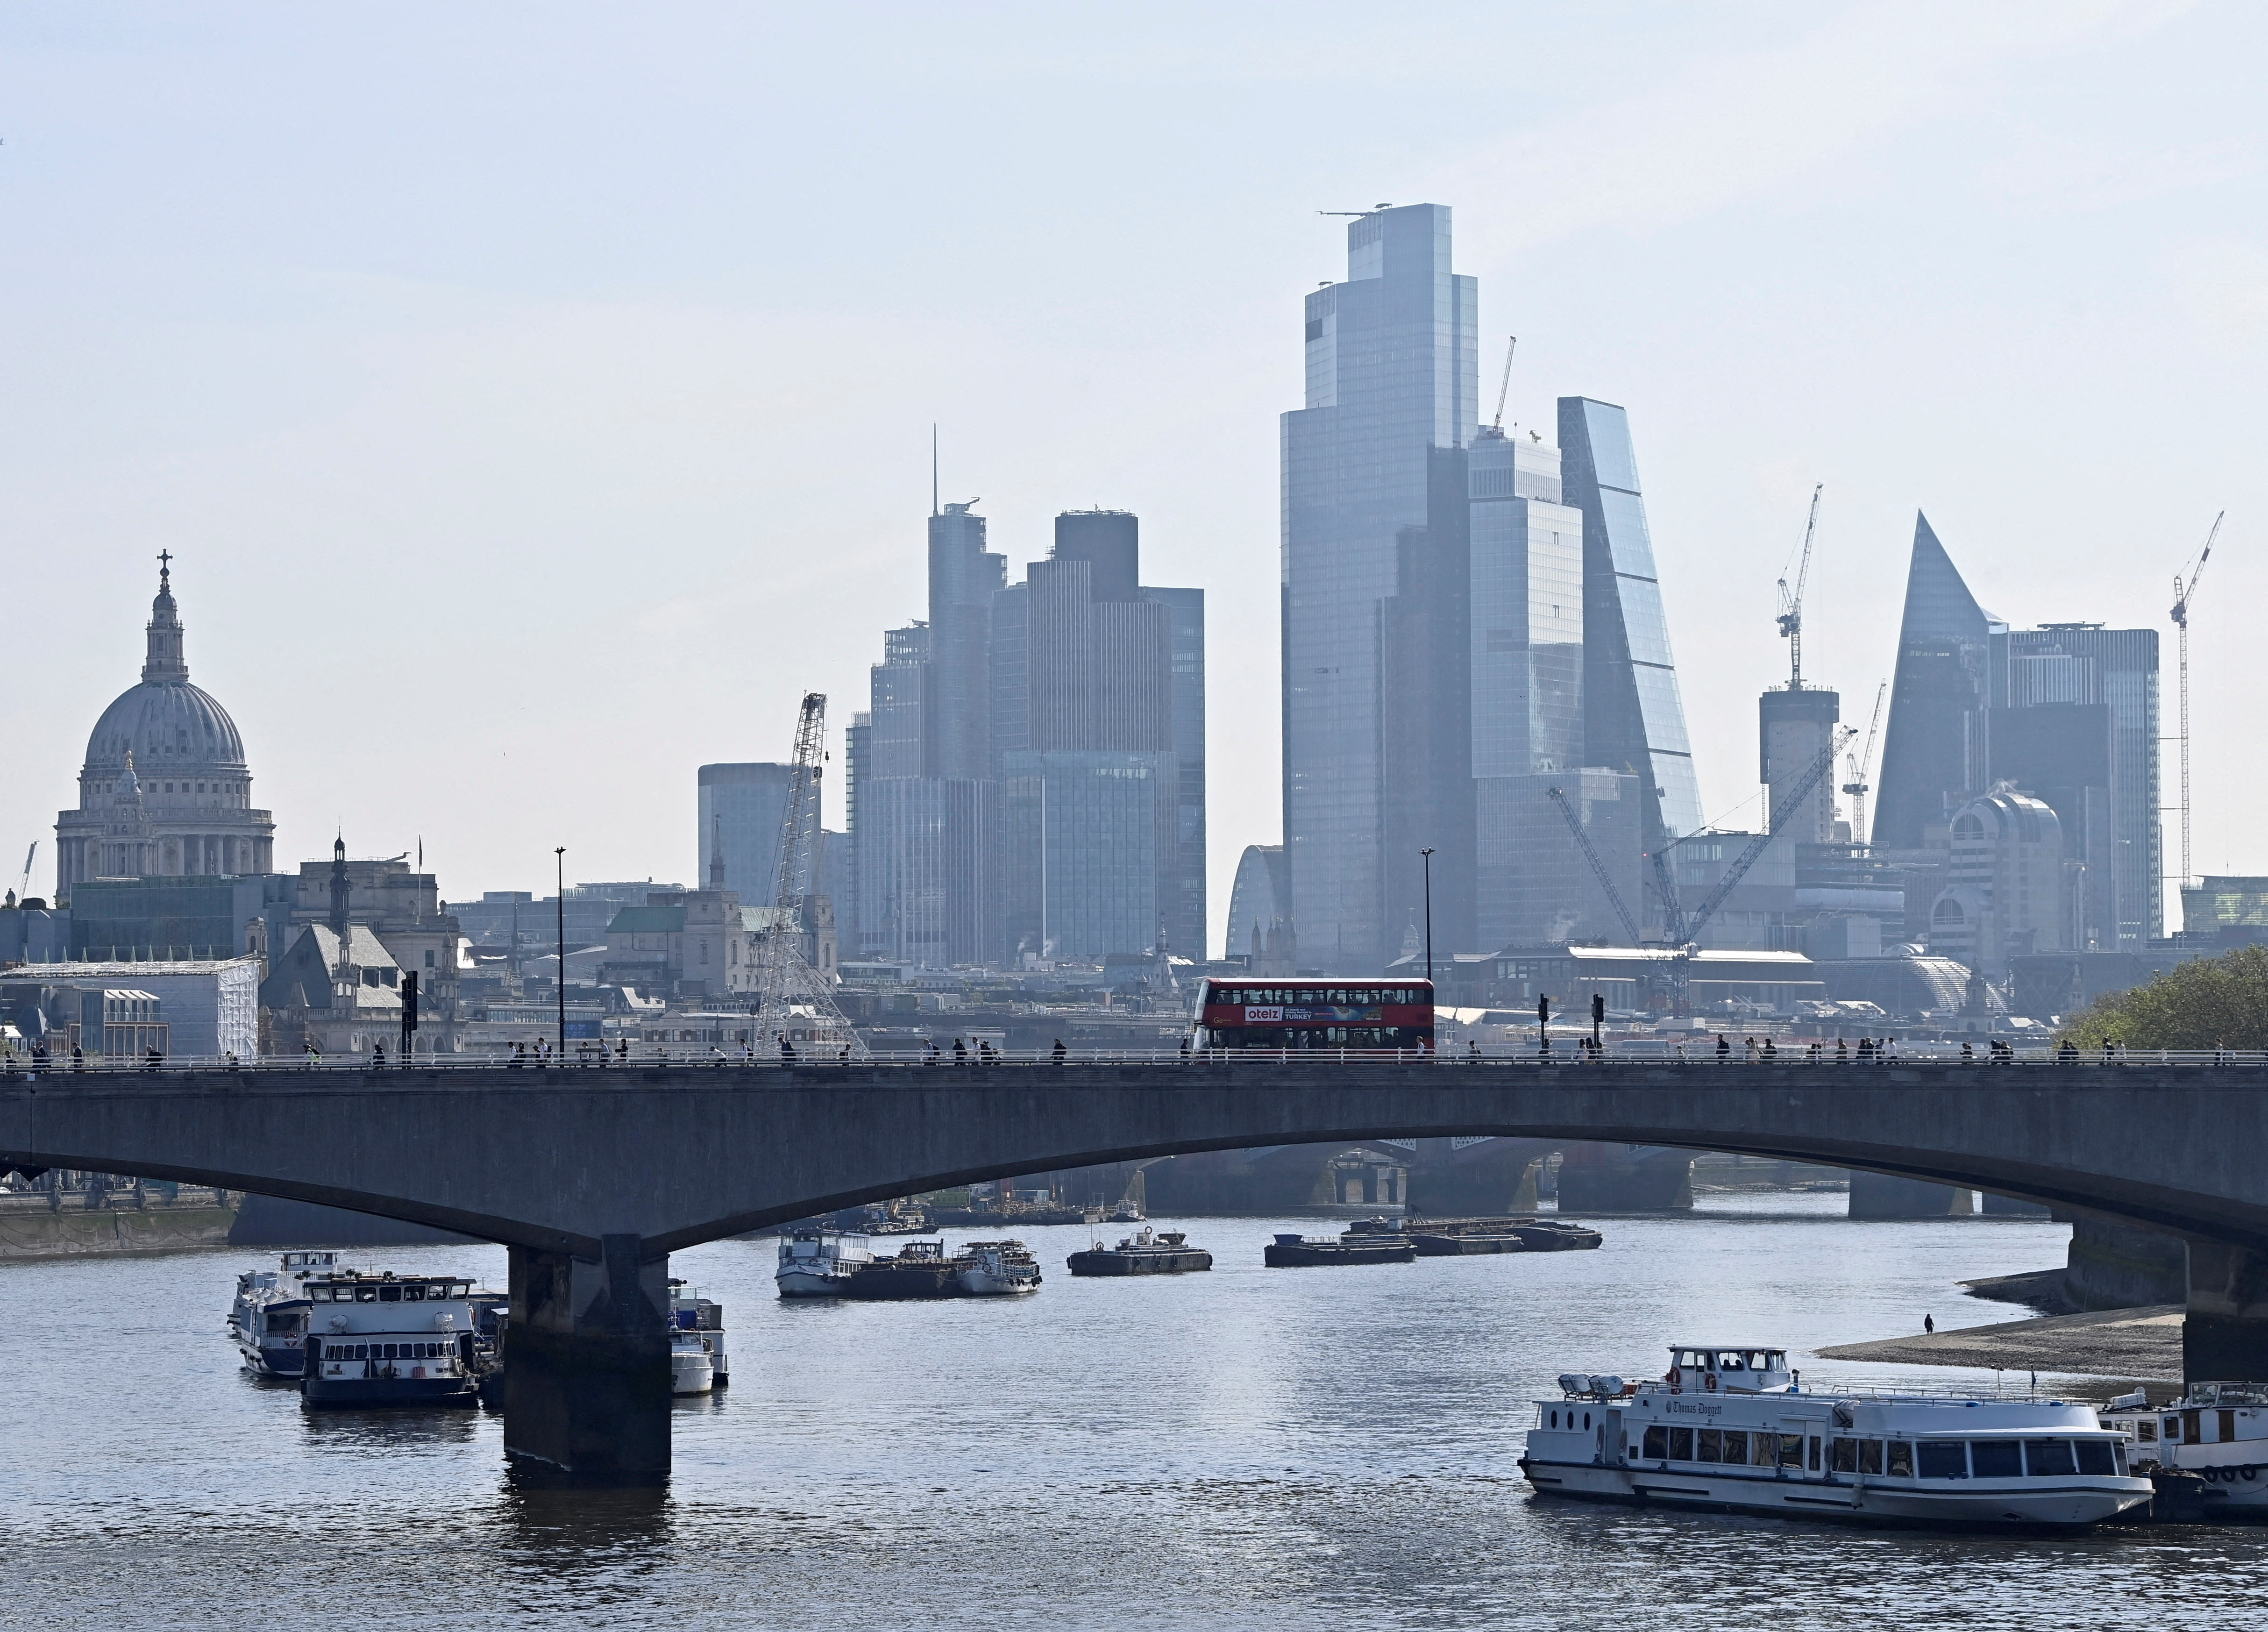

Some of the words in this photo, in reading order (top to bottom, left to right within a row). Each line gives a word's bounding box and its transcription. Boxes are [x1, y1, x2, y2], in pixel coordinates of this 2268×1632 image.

[1248, 1009, 1278, 1019] otelz
[1673, 1401, 1696, 1414] Thomas
[1699, 1403, 1721, 1417] Doggett
